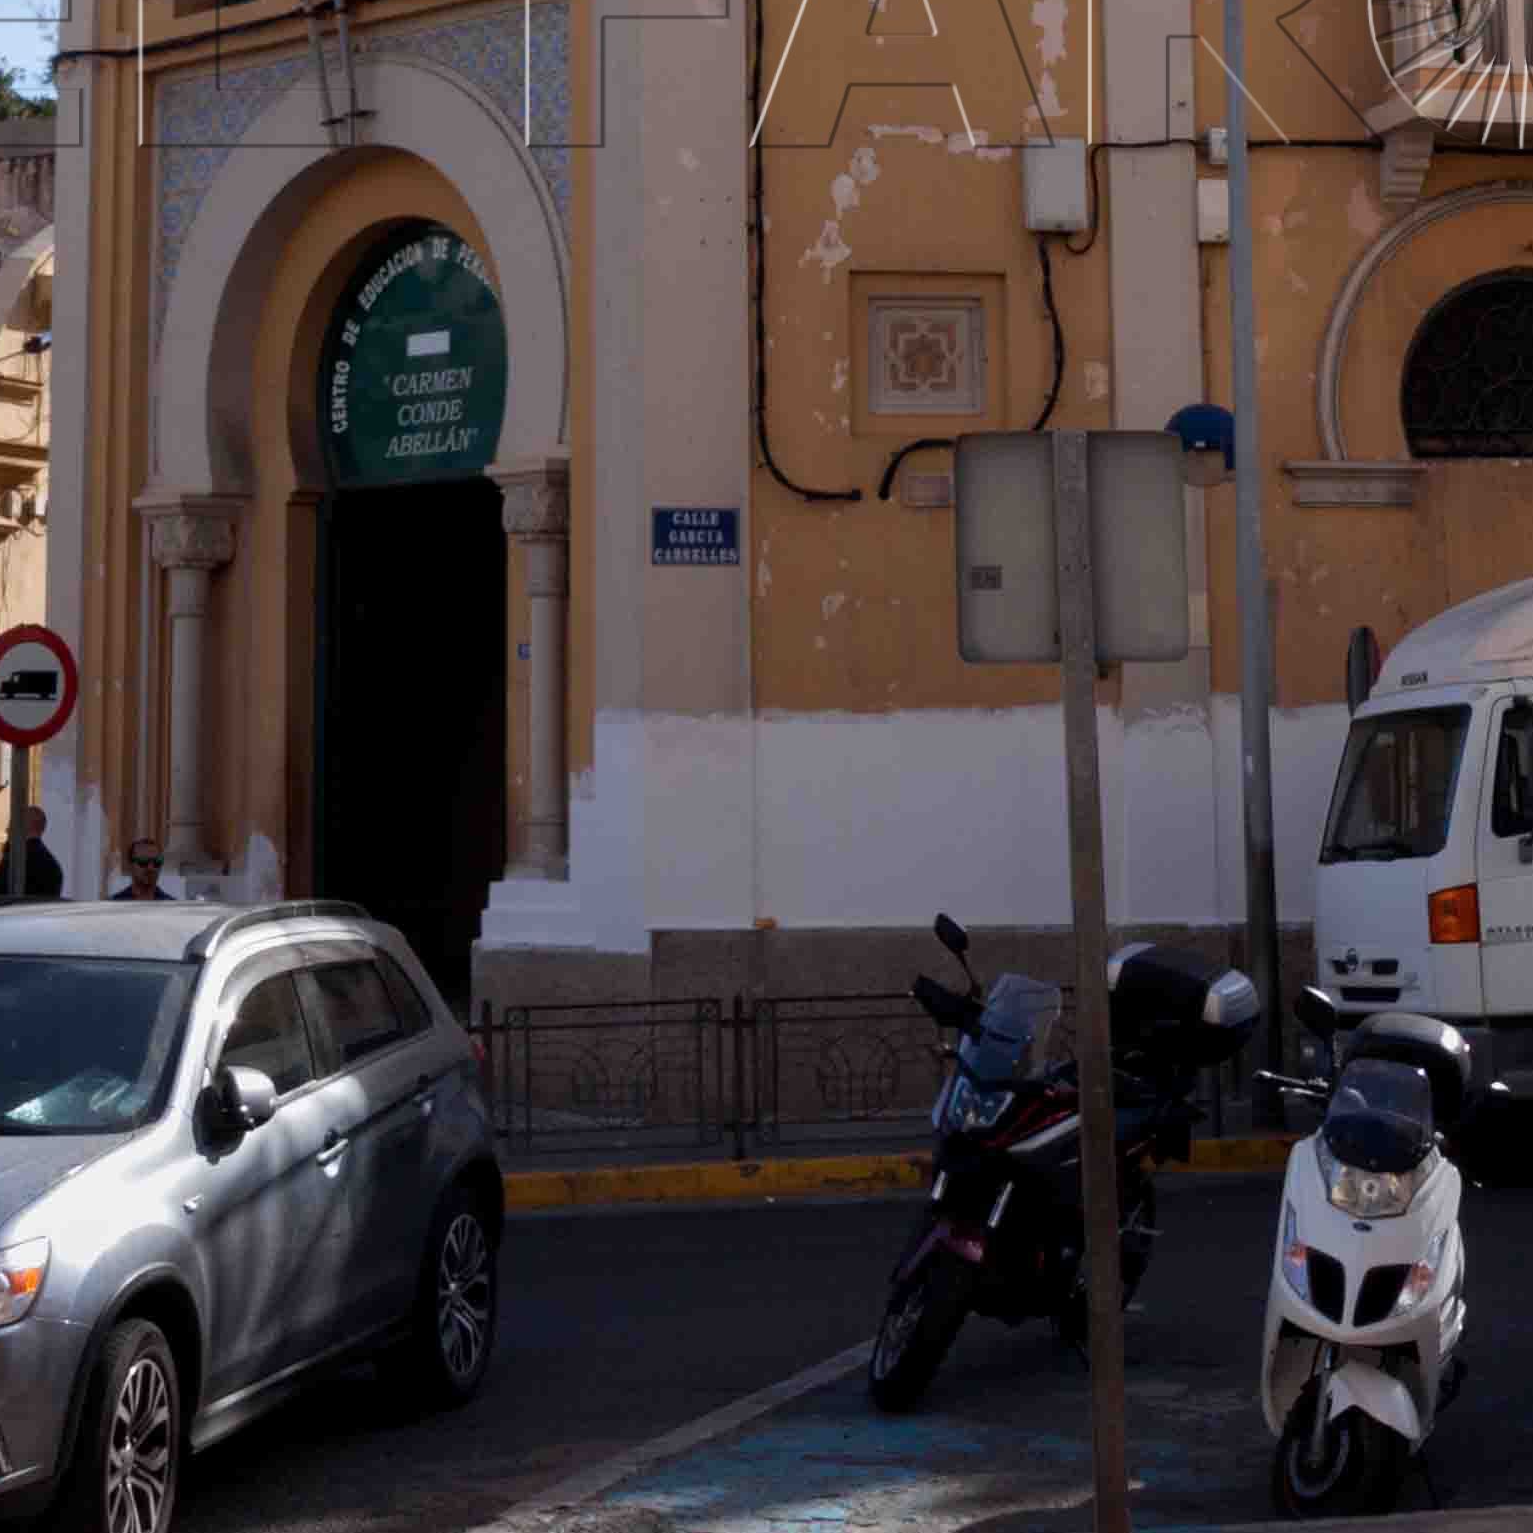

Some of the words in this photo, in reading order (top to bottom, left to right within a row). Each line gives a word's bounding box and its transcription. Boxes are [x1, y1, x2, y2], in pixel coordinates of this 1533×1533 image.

[332, 360, 350, 434] CENTRO
[342, 319, 361, 347] DE
[431, 236, 450, 260] DE
[397, 399, 463, 426] CONDE
[672, 511, 720, 526] CALLE
